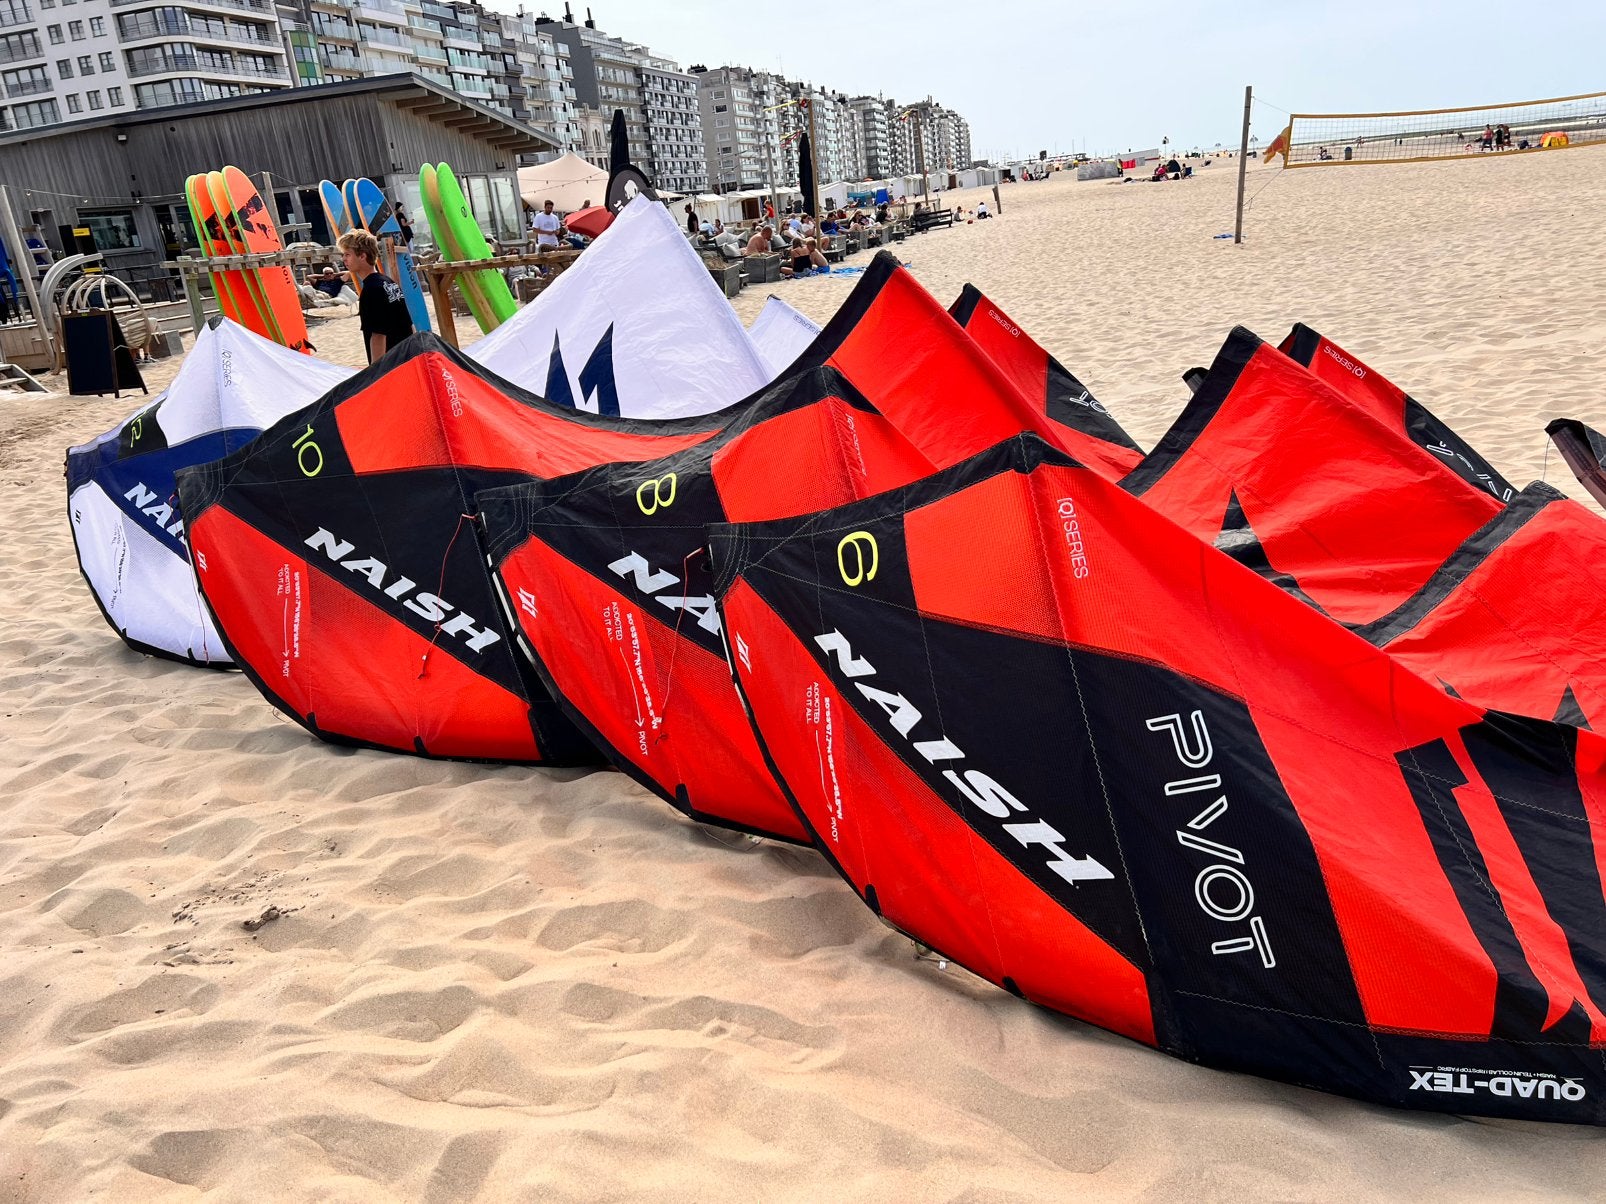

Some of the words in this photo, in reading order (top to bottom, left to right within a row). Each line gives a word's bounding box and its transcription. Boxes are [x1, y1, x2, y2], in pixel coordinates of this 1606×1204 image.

[1324, 346, 1353, 370] SERIES
[446, 381, 463, 417] SERIES
[292, 423, 323, 477] 10
[123, 481, 187, 546] NAI
[636, 472, 677, 515] 8
[837, 531, 878, 586] 6
[1064, 520, 1088, 579] SERIES
[304, 526, 501, 655] NAISH
[603, 606, 611, 618] TO
[607, 550, 721, 636] NA
[611, 602, 623, 641] ADDICTED
[638, 731, 648, 756] PIVOT
[814, 628, 1115, 885] NAISH
[831, 816, 839, 843] PIVOT
[1146, 710, 1276, 969] PIVOT
[1409, 1070, 1586, 1101] QUAD-TEX
